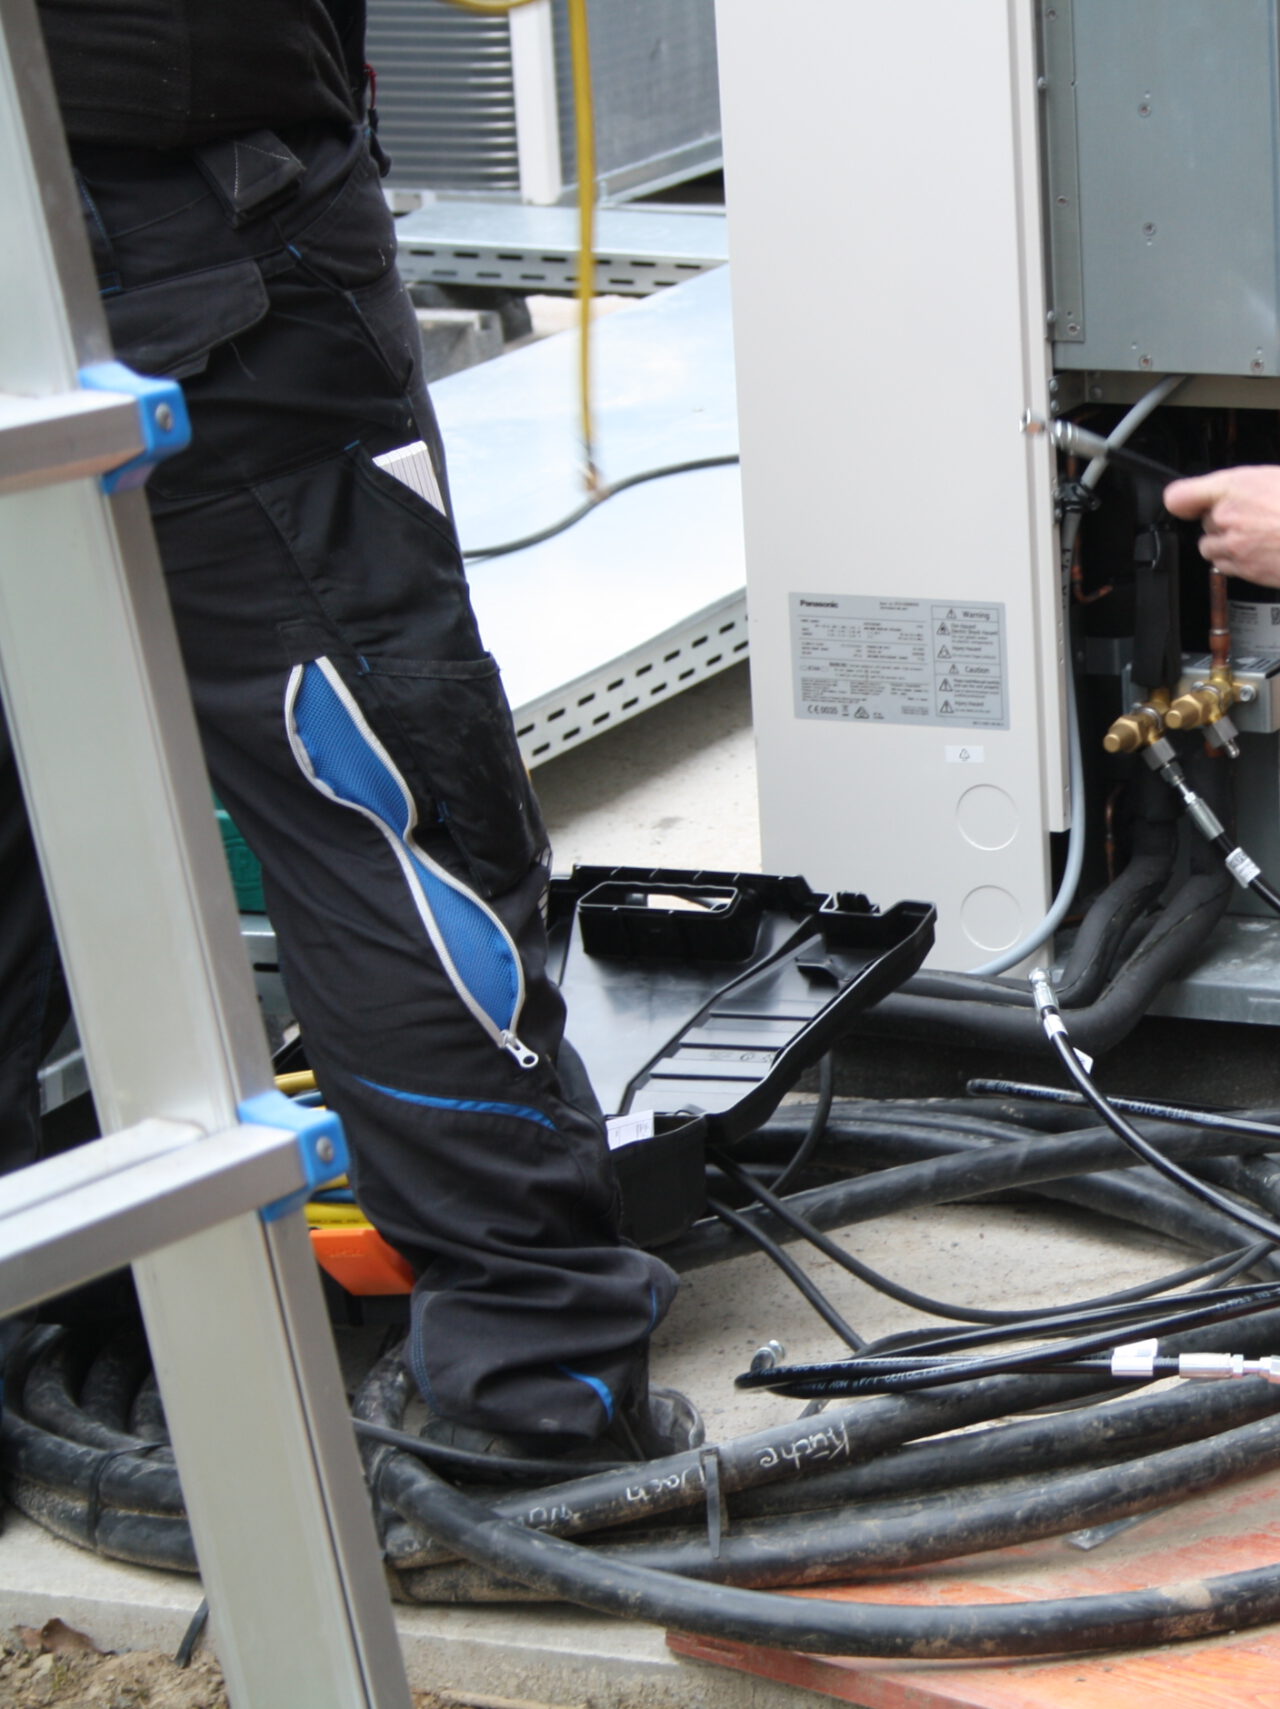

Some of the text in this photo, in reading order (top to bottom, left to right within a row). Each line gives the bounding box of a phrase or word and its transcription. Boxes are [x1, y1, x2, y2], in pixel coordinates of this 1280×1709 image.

[800, 600, 839, 608] Panasonic
[962, 611, 990, 620] Warning
[964, 665, 990, 673] Caution
